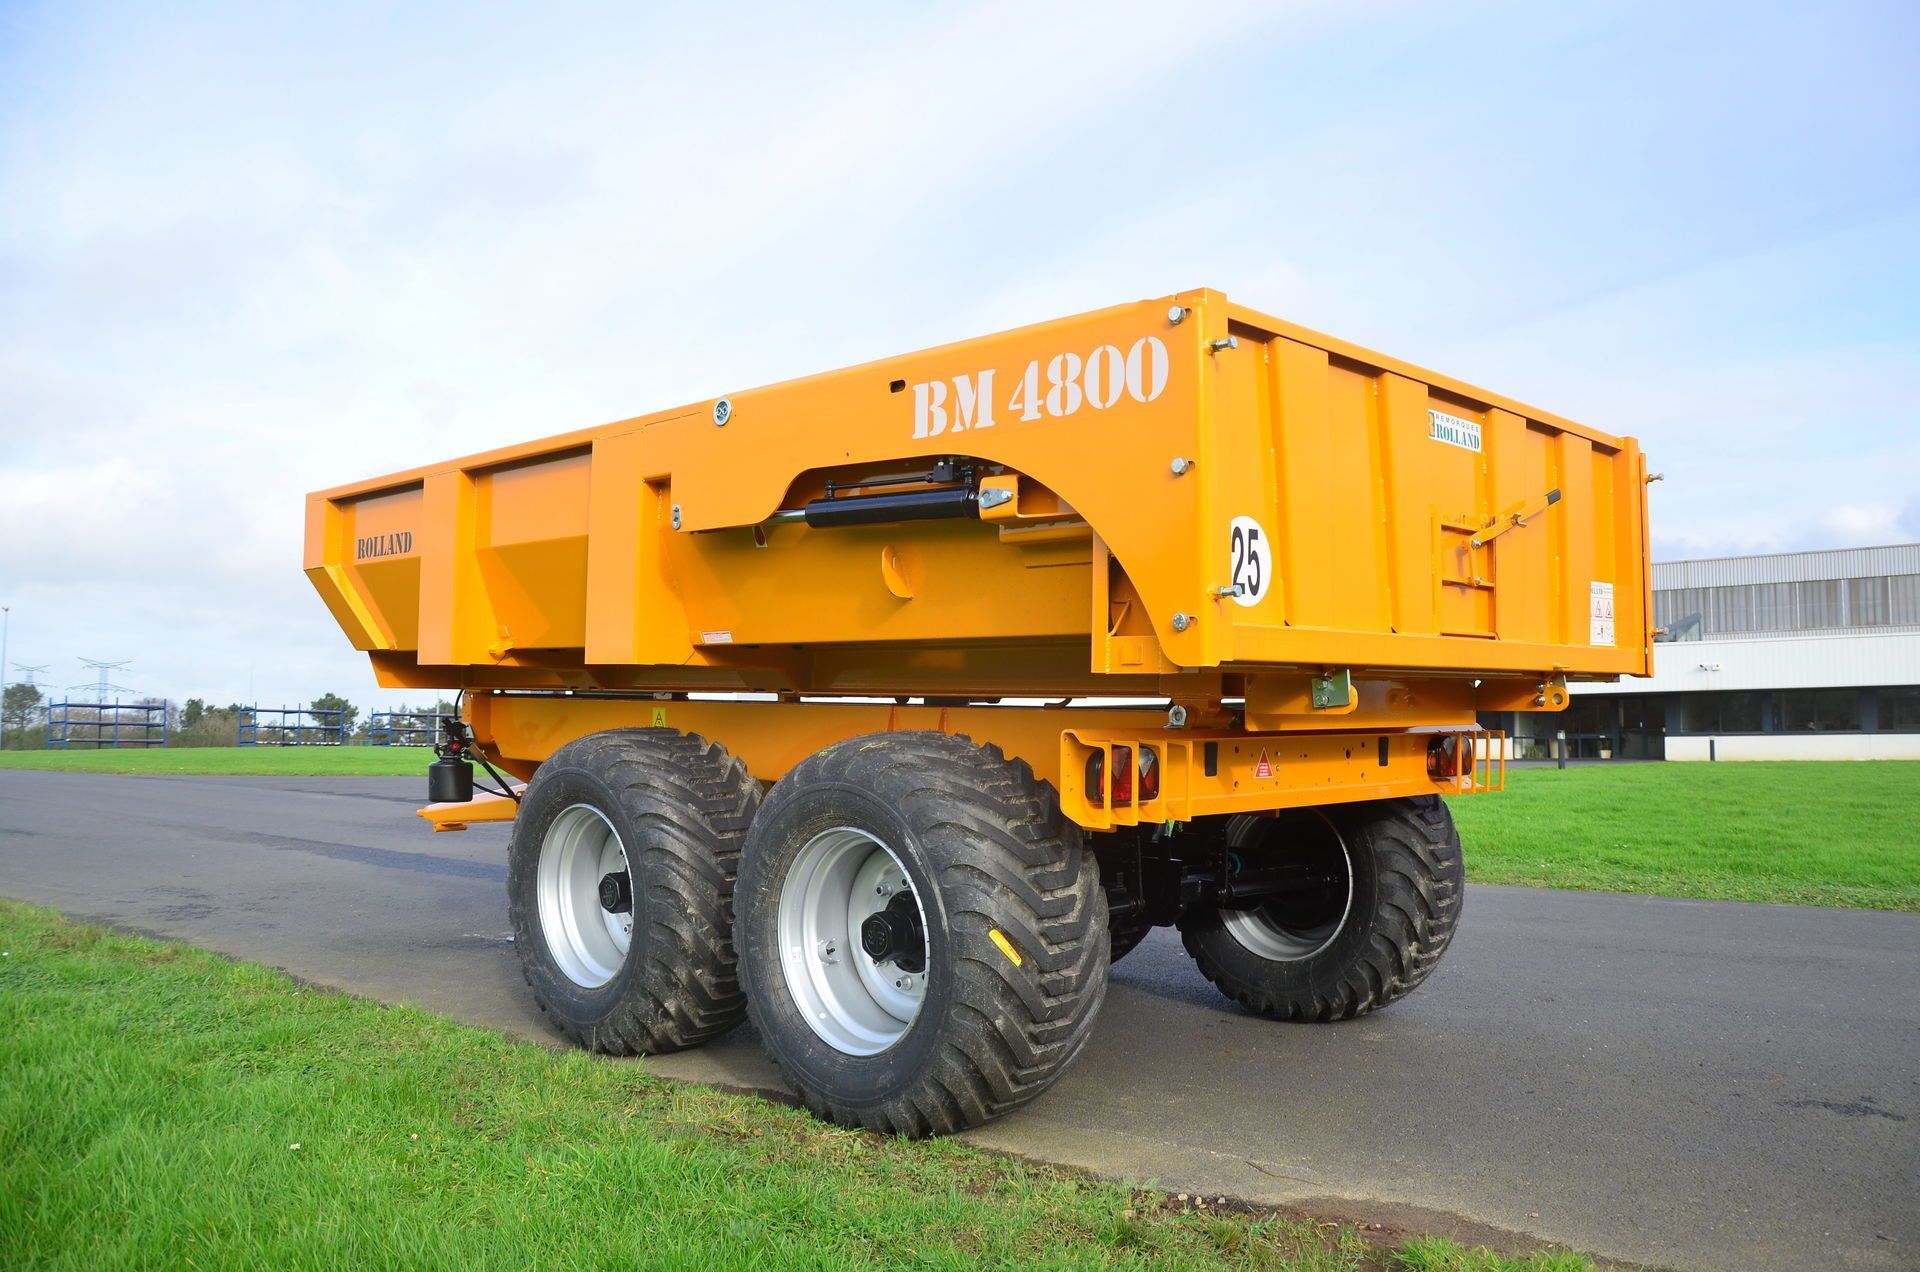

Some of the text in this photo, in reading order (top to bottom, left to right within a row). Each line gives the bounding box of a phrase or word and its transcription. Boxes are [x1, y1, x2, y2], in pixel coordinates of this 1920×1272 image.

[911, 336, 1170, 440] BM 4800
[1435, 413, 1480, 433] REMORQUES
[1436, 423, 1480, 450] ROLLAND
[357, 531, 413, 560] ROLLAND
[1231, 526, 1261, 597] 25
